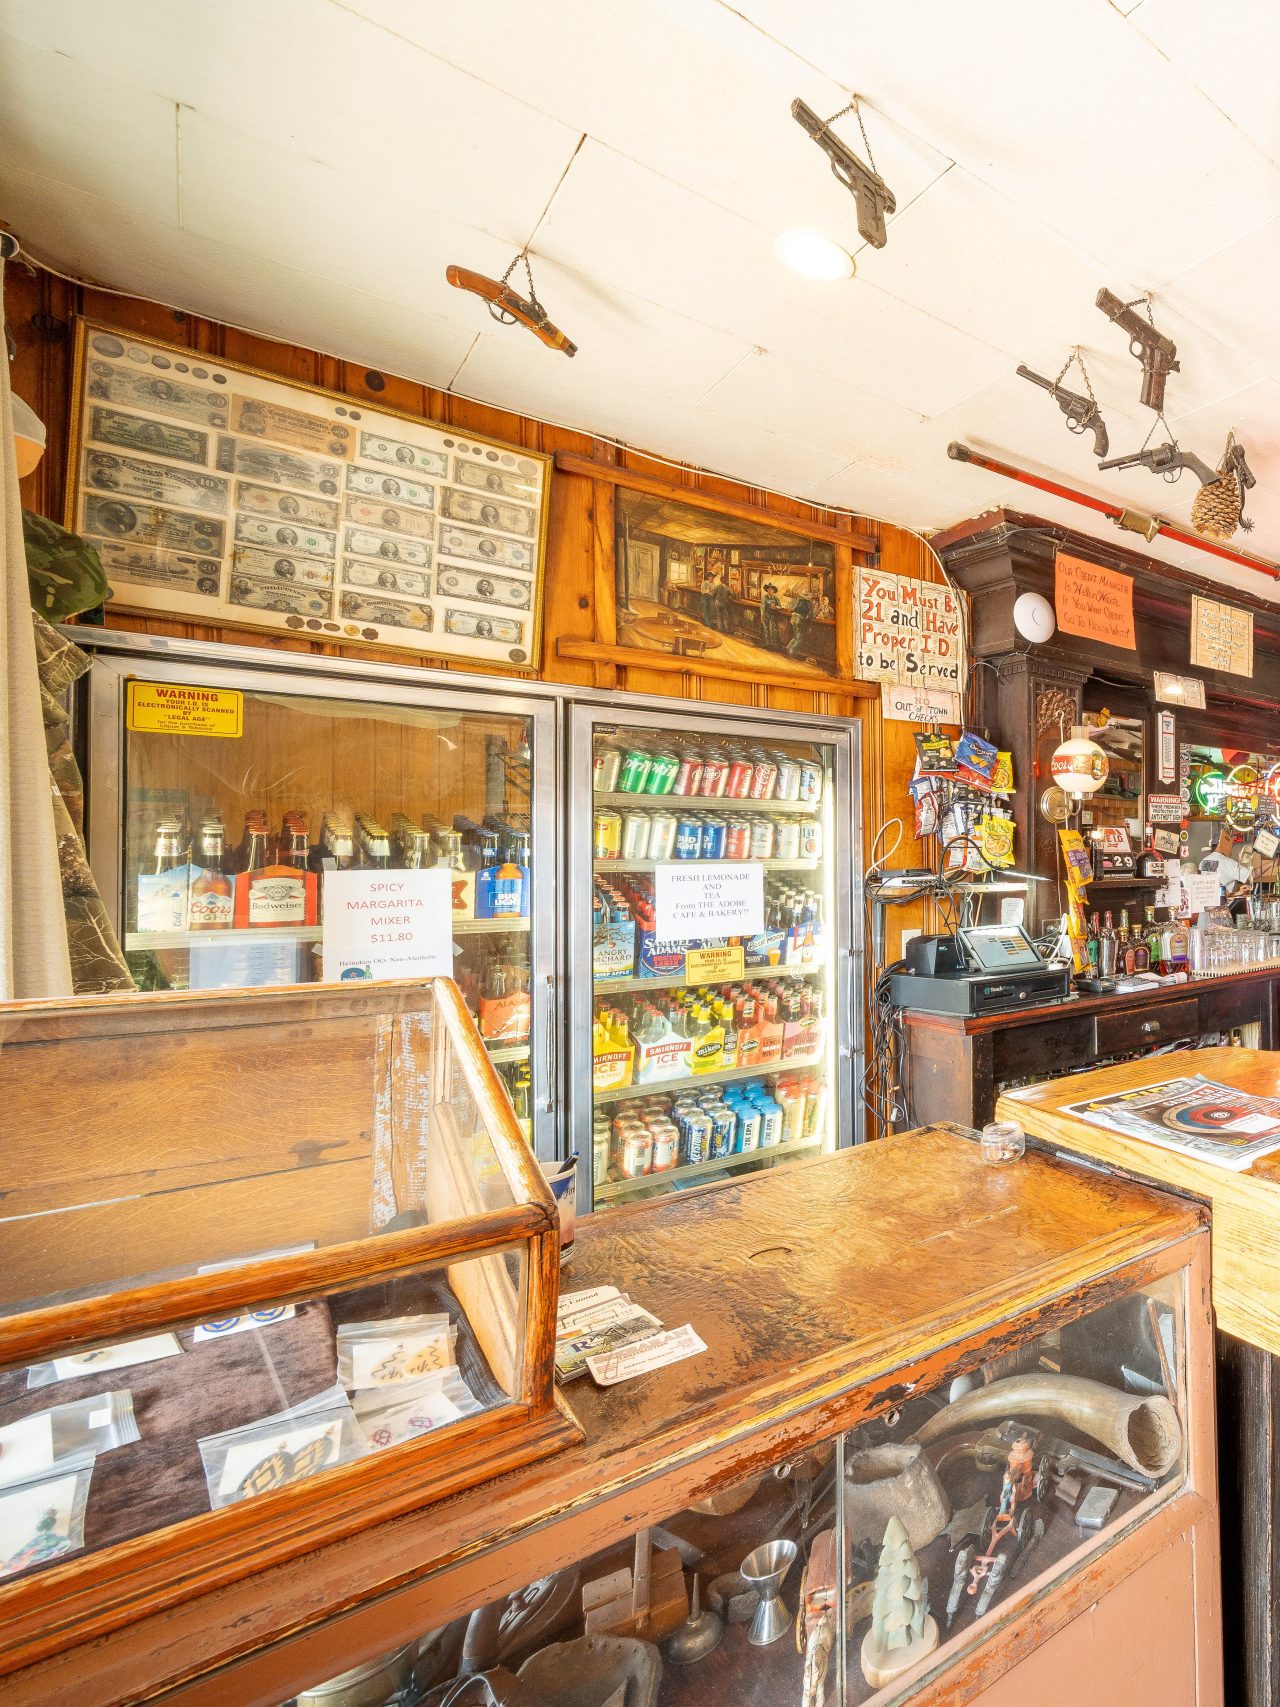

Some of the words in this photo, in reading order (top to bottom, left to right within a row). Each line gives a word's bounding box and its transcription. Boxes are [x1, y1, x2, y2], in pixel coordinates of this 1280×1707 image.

[861, 576, 897, 601] You
[901, 585, 939, 610] Must
[944, 594, 958, 614] Be
[862, 599, 884, 623] 21
[891, 609, 920, 629] and
[926, 611, 959, 636] Have
[862, 622, 915, 652] Proper
[859, 651, 874, 667] to
[880, 652, 896, 670] be
[906, 653, 959, 679] Served
[156, 689, 218, 702] WARNING
[138, 702, 200, 712] ELECTRONICALLY
[895, 701, 913, 712] OUT
[927, 706, 948, 716] TOWN
[908, 711, 939, 723] CHECKS
[1150, 796, 1181, 804] WARNING!
[1113, 856, 1133, 867] 29
[702, 873, 750, 881] LEMONADE
[370, 883, 404, 892] SPICY
[191, 901, 232, 914] Coors
[252, 901, 302, 911] Budweiser
[347, 899, 424, 910] MARGARITA
[675, 902, 696, 910] From
[699, 901, 716, 909] THE
[718, 900, 747, 908] ADOBE
[672, 911, 698, 919] CAFE
[371, 916, 411, 926] MIXER
[371, 933, 413, 943] $11.80
[644, 938, 693, 949] SAMUEL
[747, 939, 765, 951] BLUE
[767, 933, 785, 943] MOON
[598, 948, 628, 957] ANGRY
[647, 946, 688, 957] ADAMS
[700, 950, 732, 960] WARNING
[649, 1043, 688, 1055] SMIRNOFF
[657, 1053, 679, 1064] ICE
[594, 1063, 617, 1073] ICE
